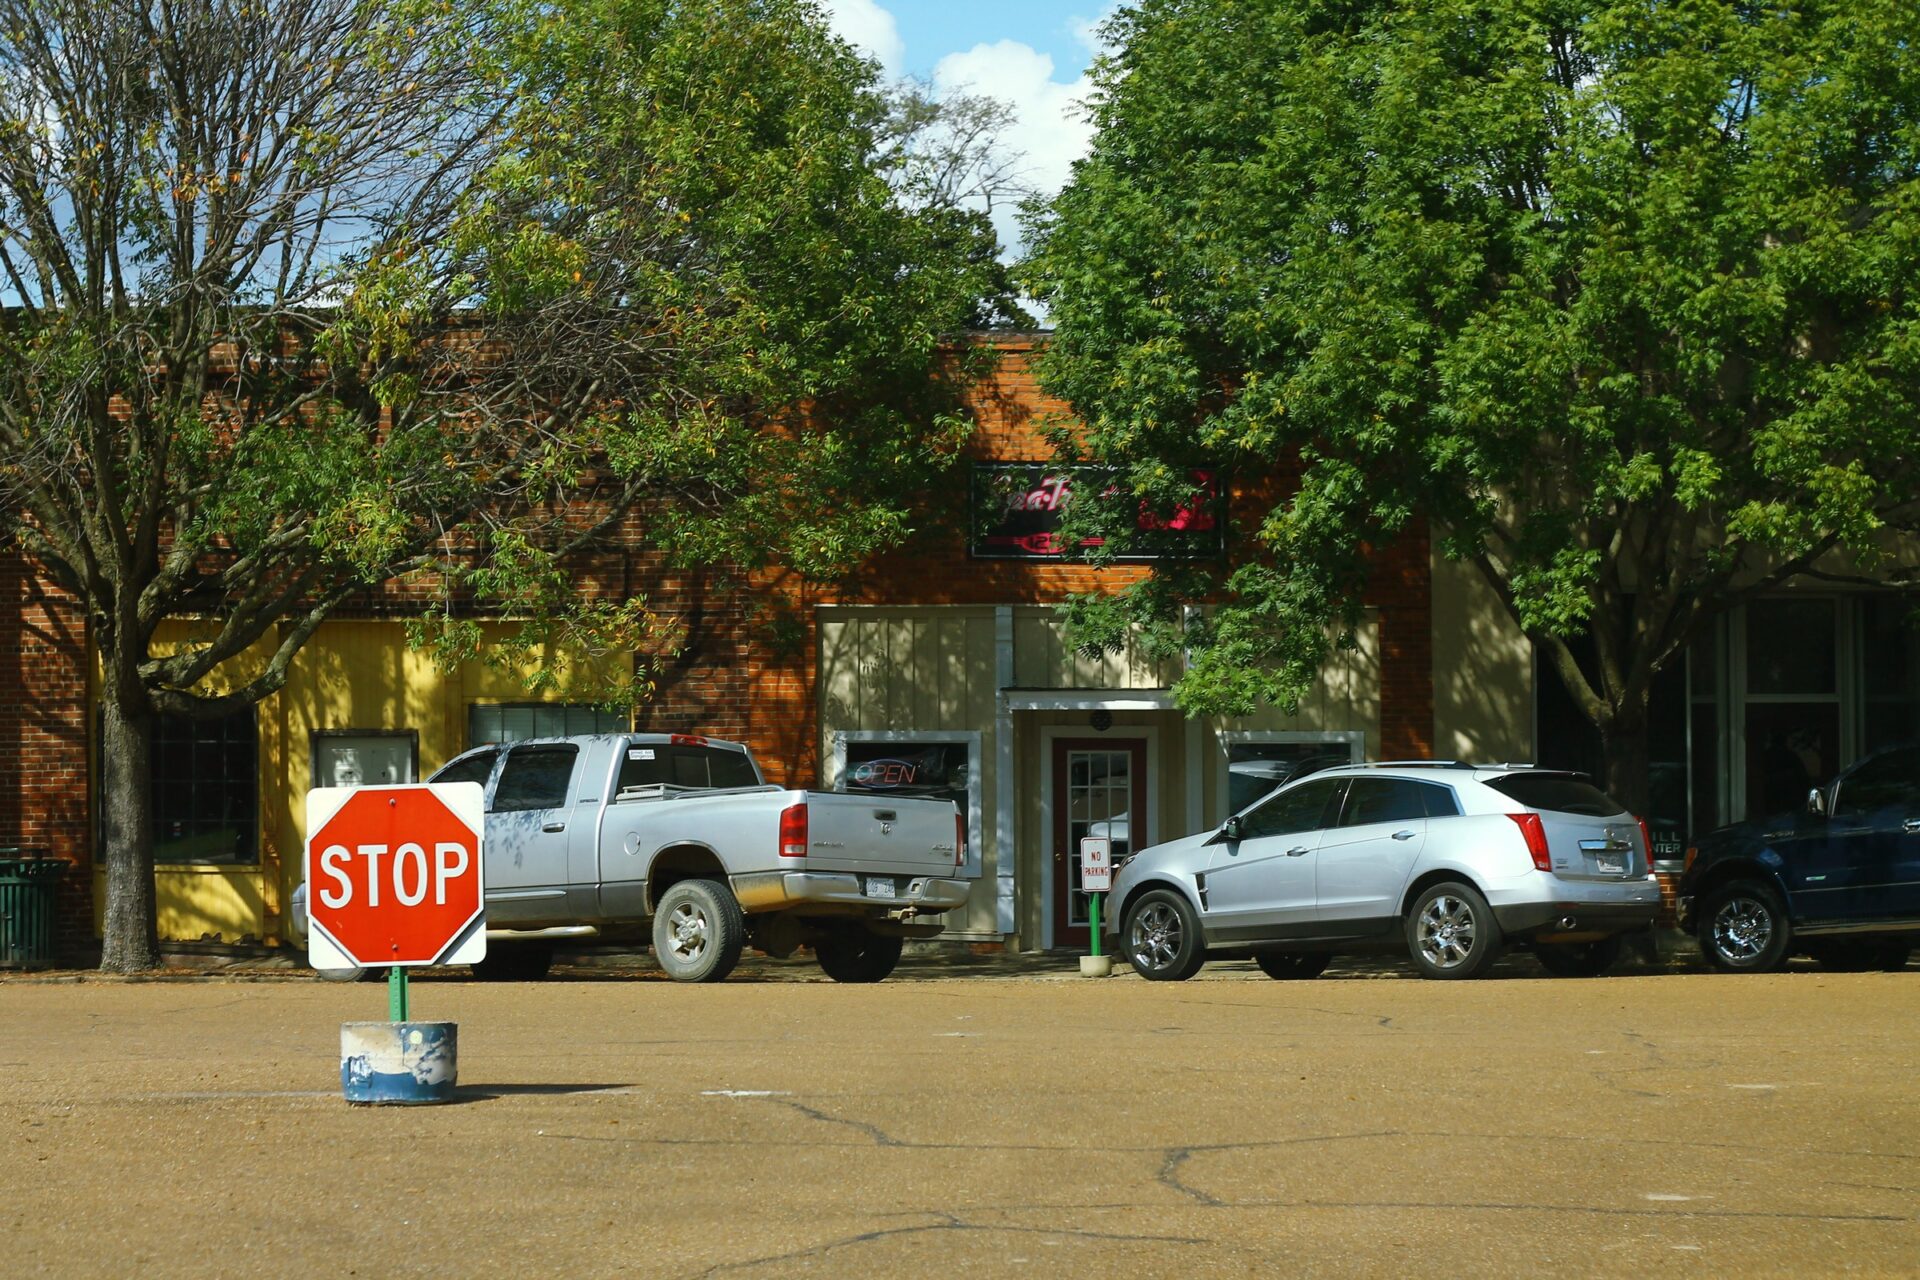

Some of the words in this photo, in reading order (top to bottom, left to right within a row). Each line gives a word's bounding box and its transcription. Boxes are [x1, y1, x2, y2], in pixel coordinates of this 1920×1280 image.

[855, 764, 916, 784] OPEN
[1091, 851, 1102, 862] NO
[320, 842, 469, 909] STOP
[1084, 866, 1109, 877] PARKING
